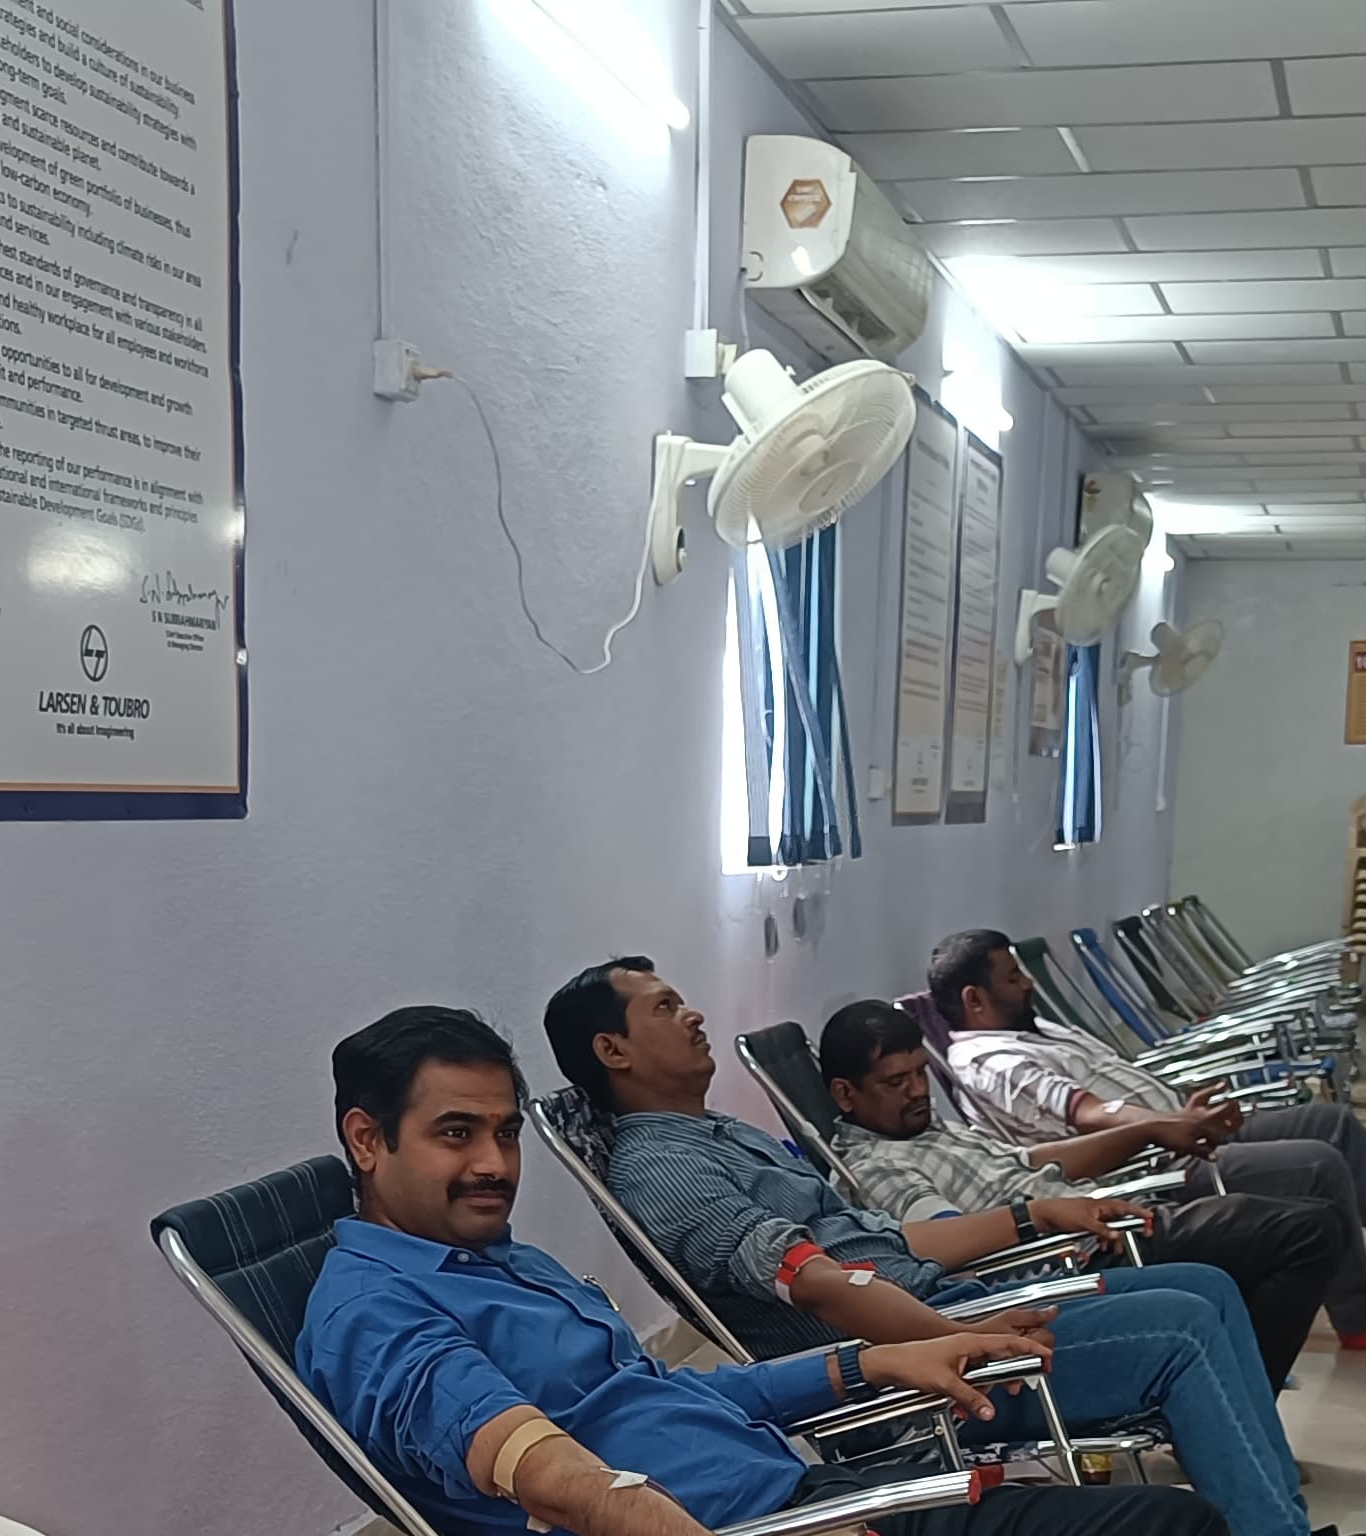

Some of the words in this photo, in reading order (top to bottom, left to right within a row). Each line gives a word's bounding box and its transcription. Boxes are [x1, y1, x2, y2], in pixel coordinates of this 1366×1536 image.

[2, 113, 19, 131] and
[8, 370, 25, 386] and
[62, 362, 72, 378] to
[73, 366, 83, 381] all
[30, 473, 47, 489] and
[39, 690, 85, 713] LARSEN
[89, 695, 99, 716] &
[102, 695, 150, 719] TOUBRO
